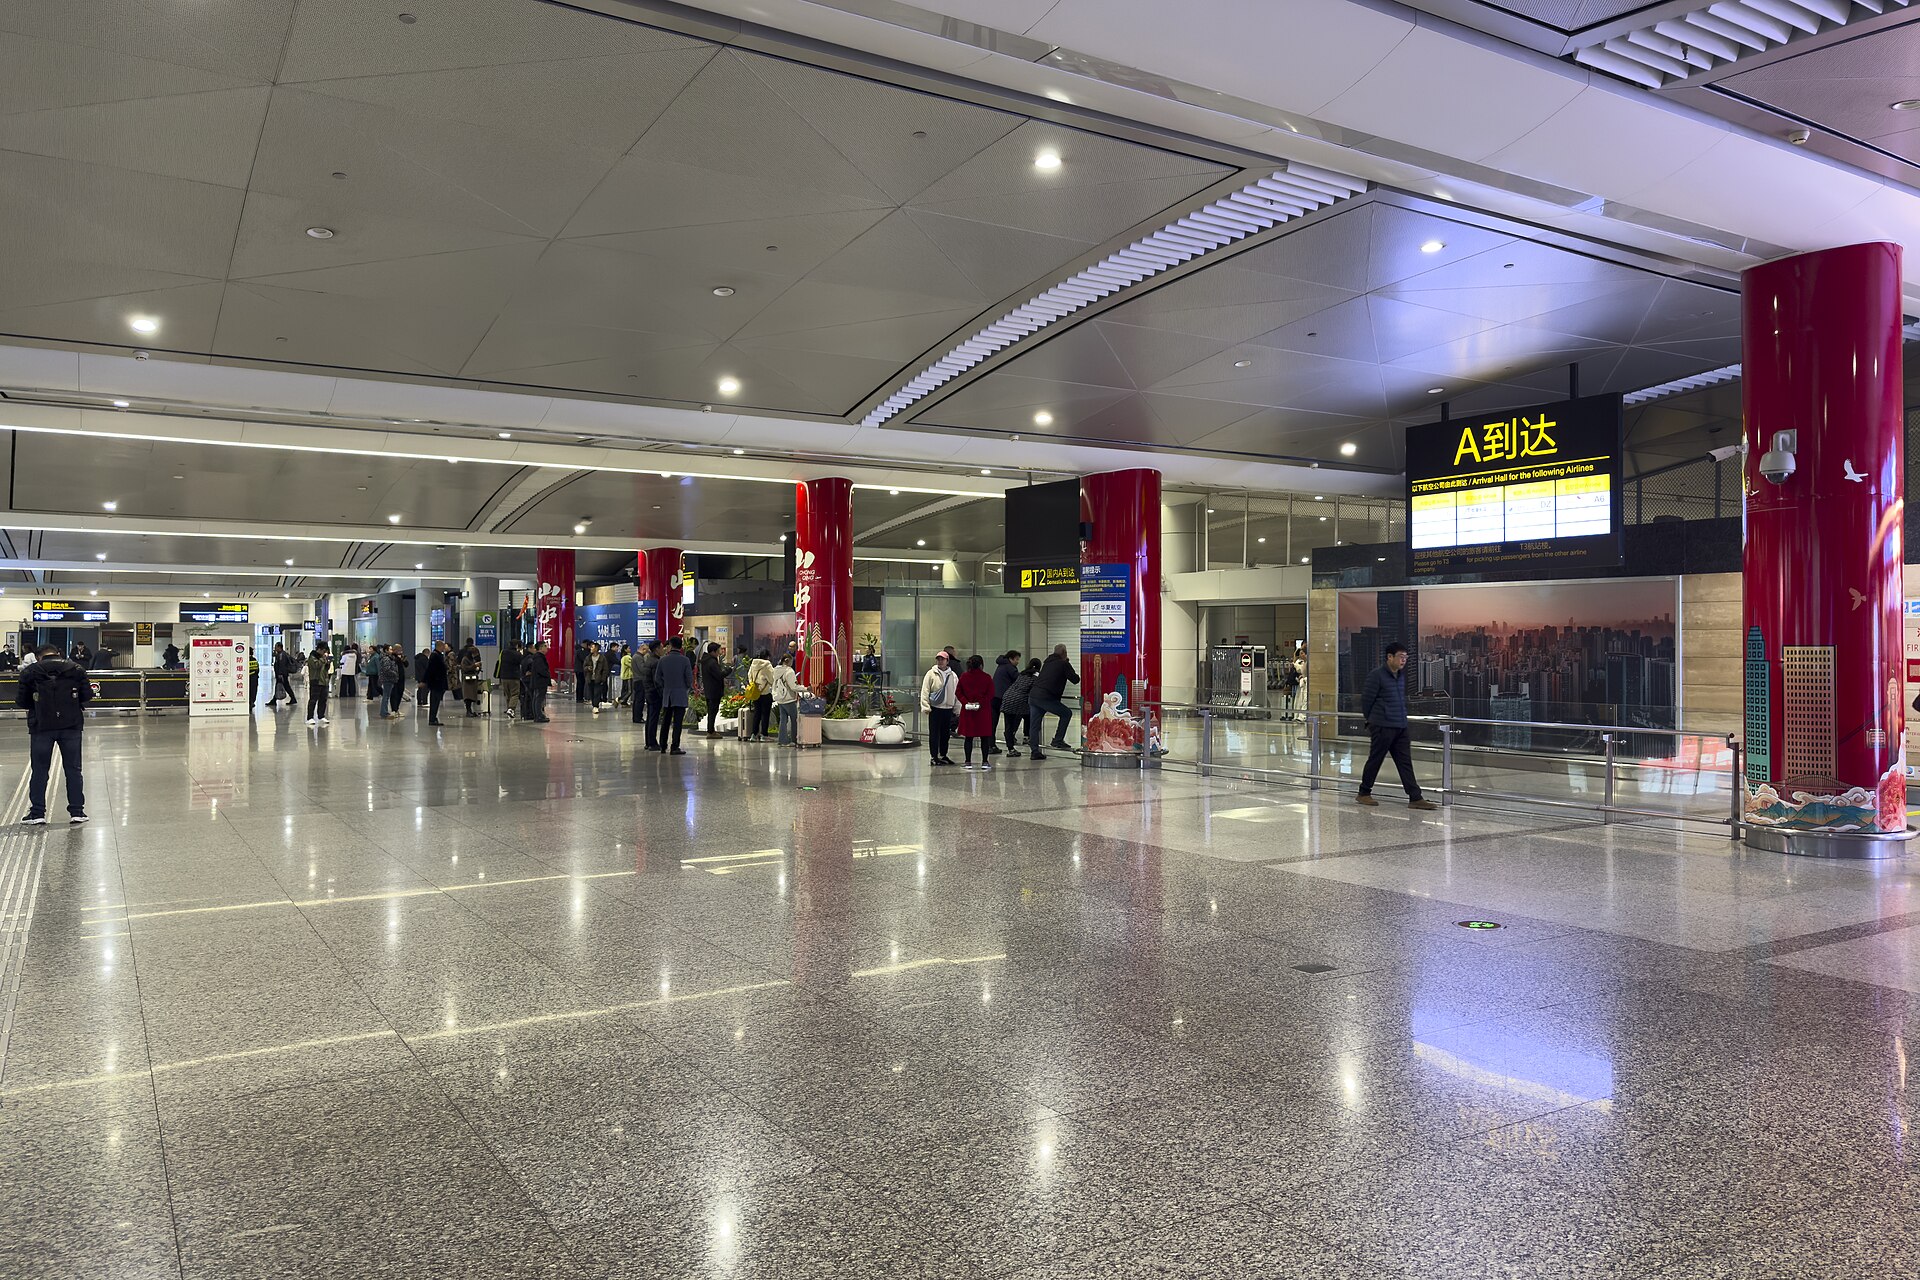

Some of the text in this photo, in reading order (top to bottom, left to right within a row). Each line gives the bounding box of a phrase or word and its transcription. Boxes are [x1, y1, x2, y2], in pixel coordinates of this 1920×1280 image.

[1453, 413, 1558, 466] A到达
[1472, 474, 1494, 486] Arrival
[1494, 473, 1508, 483] Hall
[1508, 472, 1519, 481] for
[1519, 471, 1532, 480] the
[1532, 467, 1565, 478] following
[1565, 464, 1594, 474] Airlines
[1474, 555, 1493, 563] picking
[1501, 552, 1531, 561] passengers
[1032, 567, 1075, 587] T2 国内A到达
[236, 656, 244, 698] 防爆安检点
